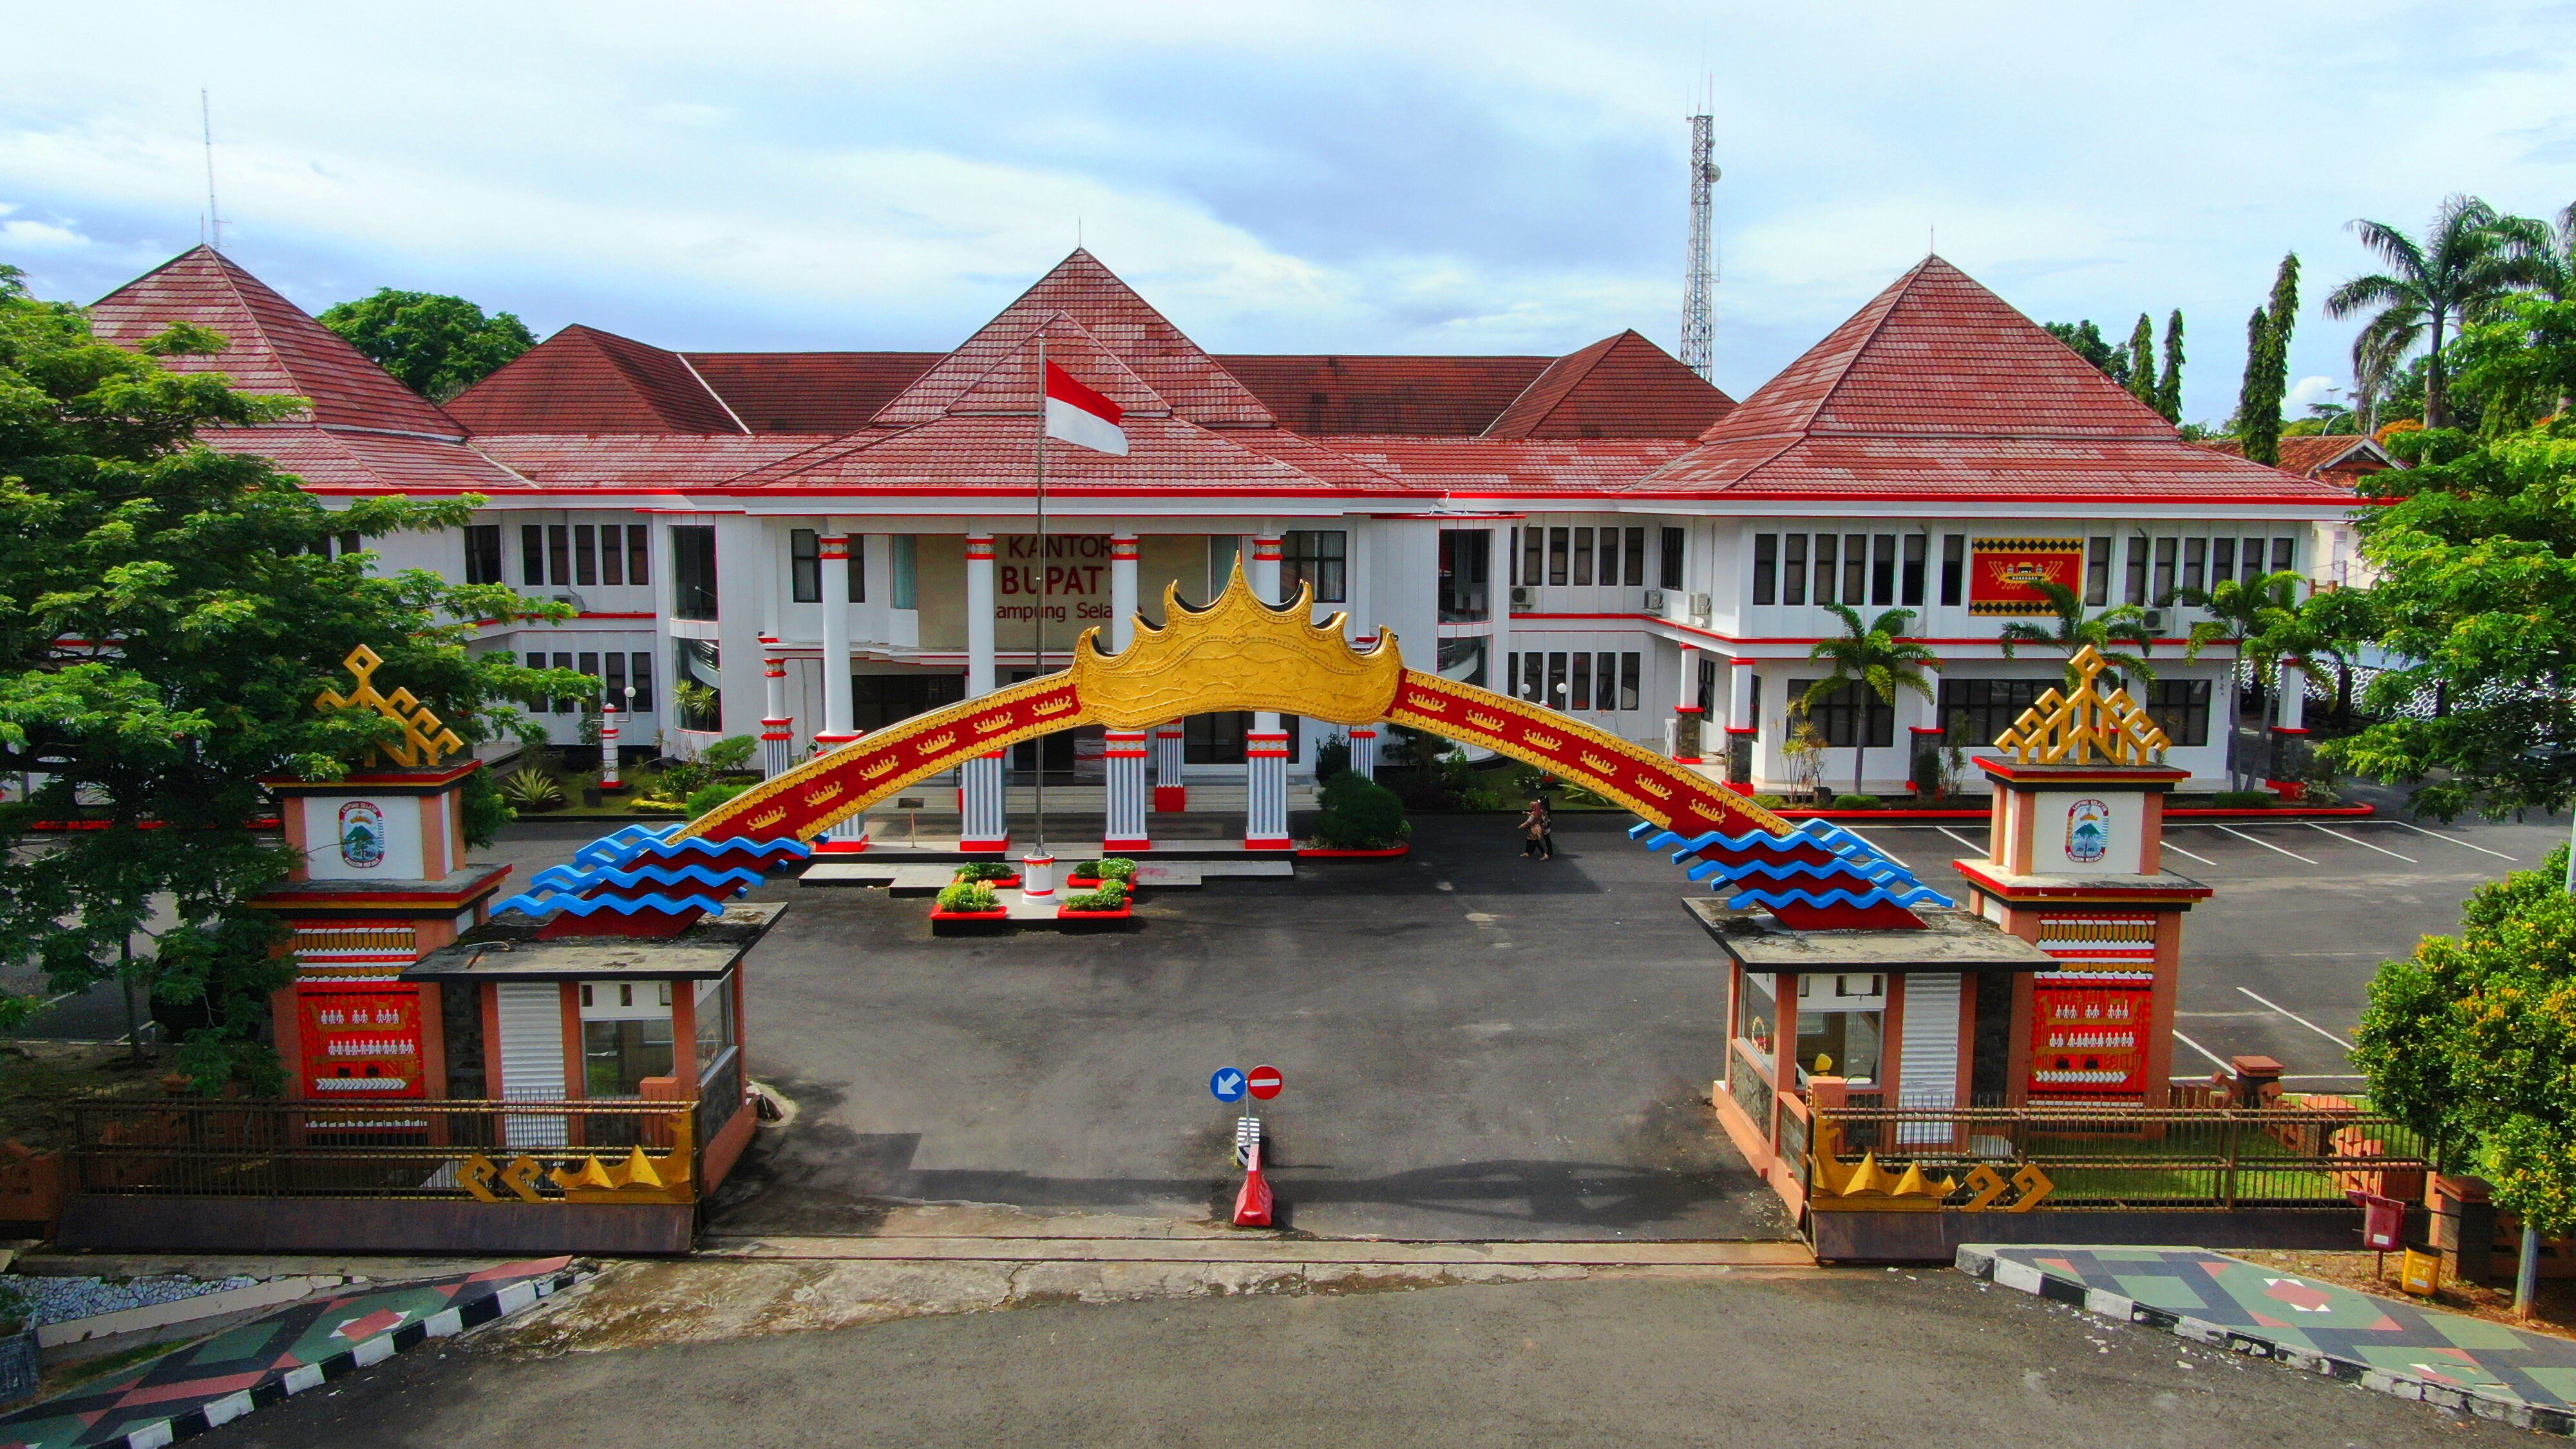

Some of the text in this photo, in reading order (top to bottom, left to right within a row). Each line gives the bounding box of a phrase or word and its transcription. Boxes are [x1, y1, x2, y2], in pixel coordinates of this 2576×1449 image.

[1009, 536, 1112, 558] KANTOR
[1001, 565, 1113, 595] BUPAT
[994, 601, 1142, 623] ampung Sela
